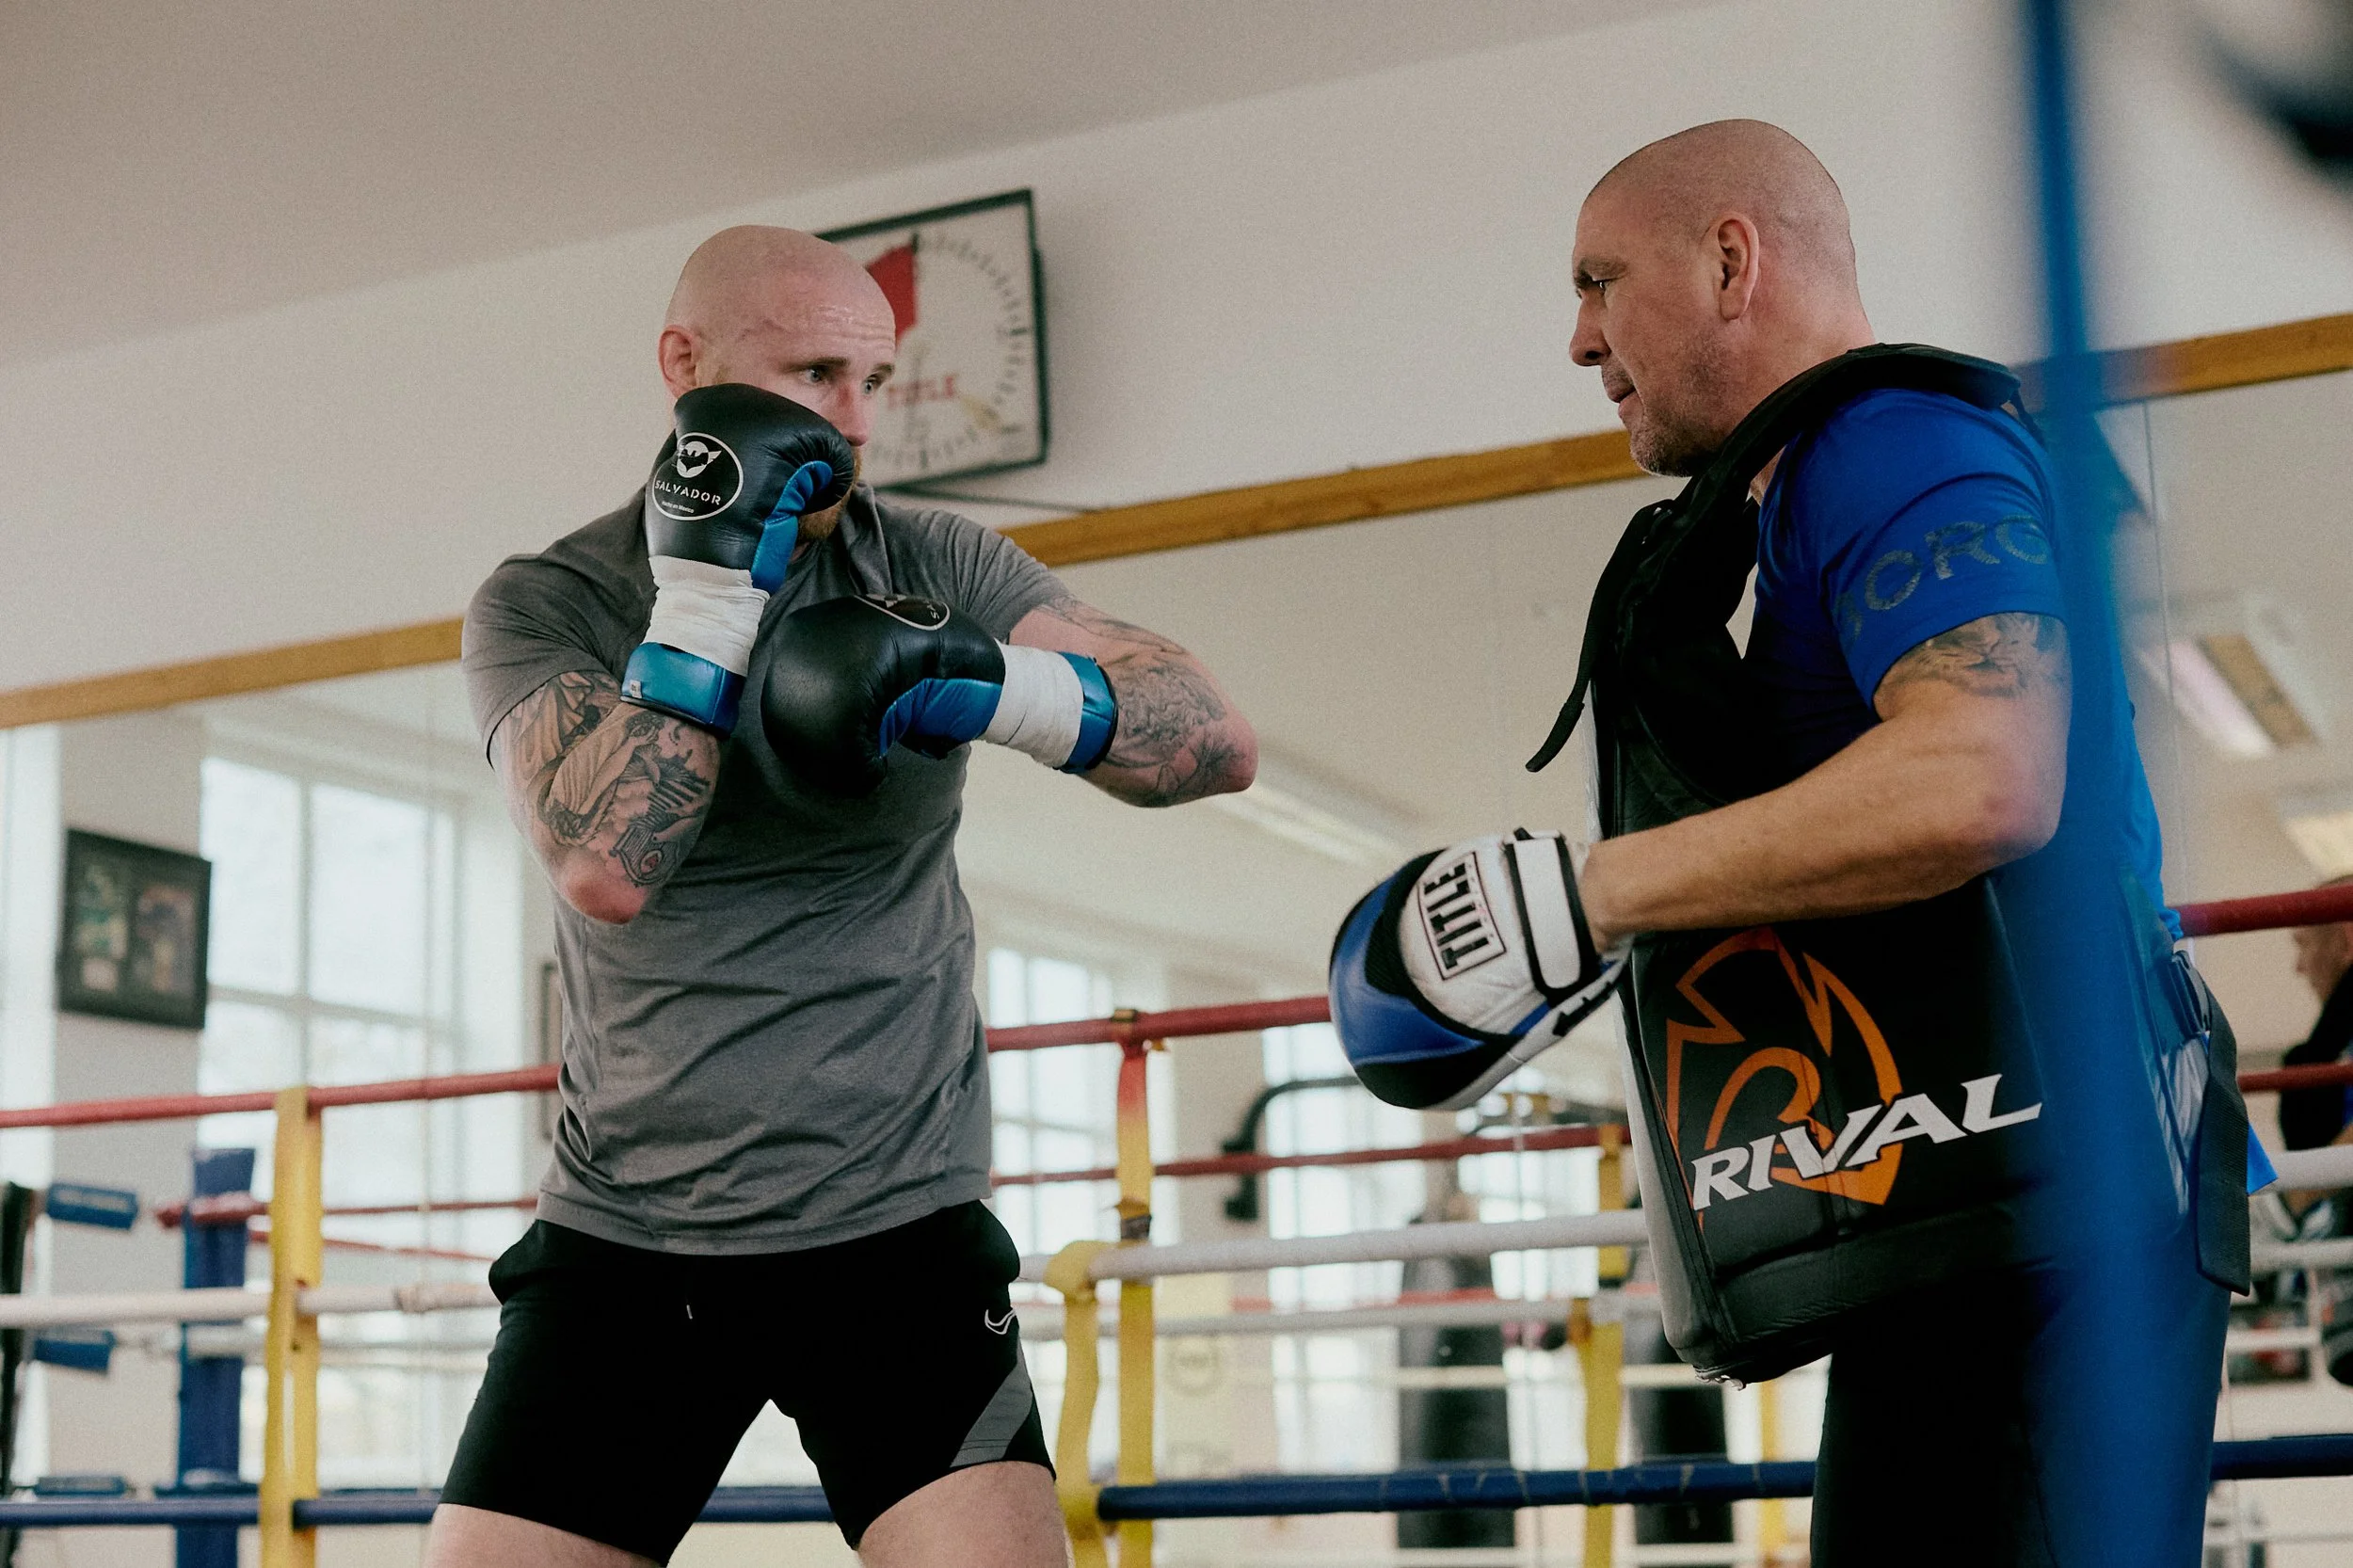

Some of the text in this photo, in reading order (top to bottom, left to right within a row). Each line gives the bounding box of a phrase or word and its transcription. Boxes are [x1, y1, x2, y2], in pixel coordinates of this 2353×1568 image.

[655, 480, 721, 505] SALVADOR
[1424, 863, 1489, 969] TITLE
[1691, 1074, 2042, 1211] RIVAL
